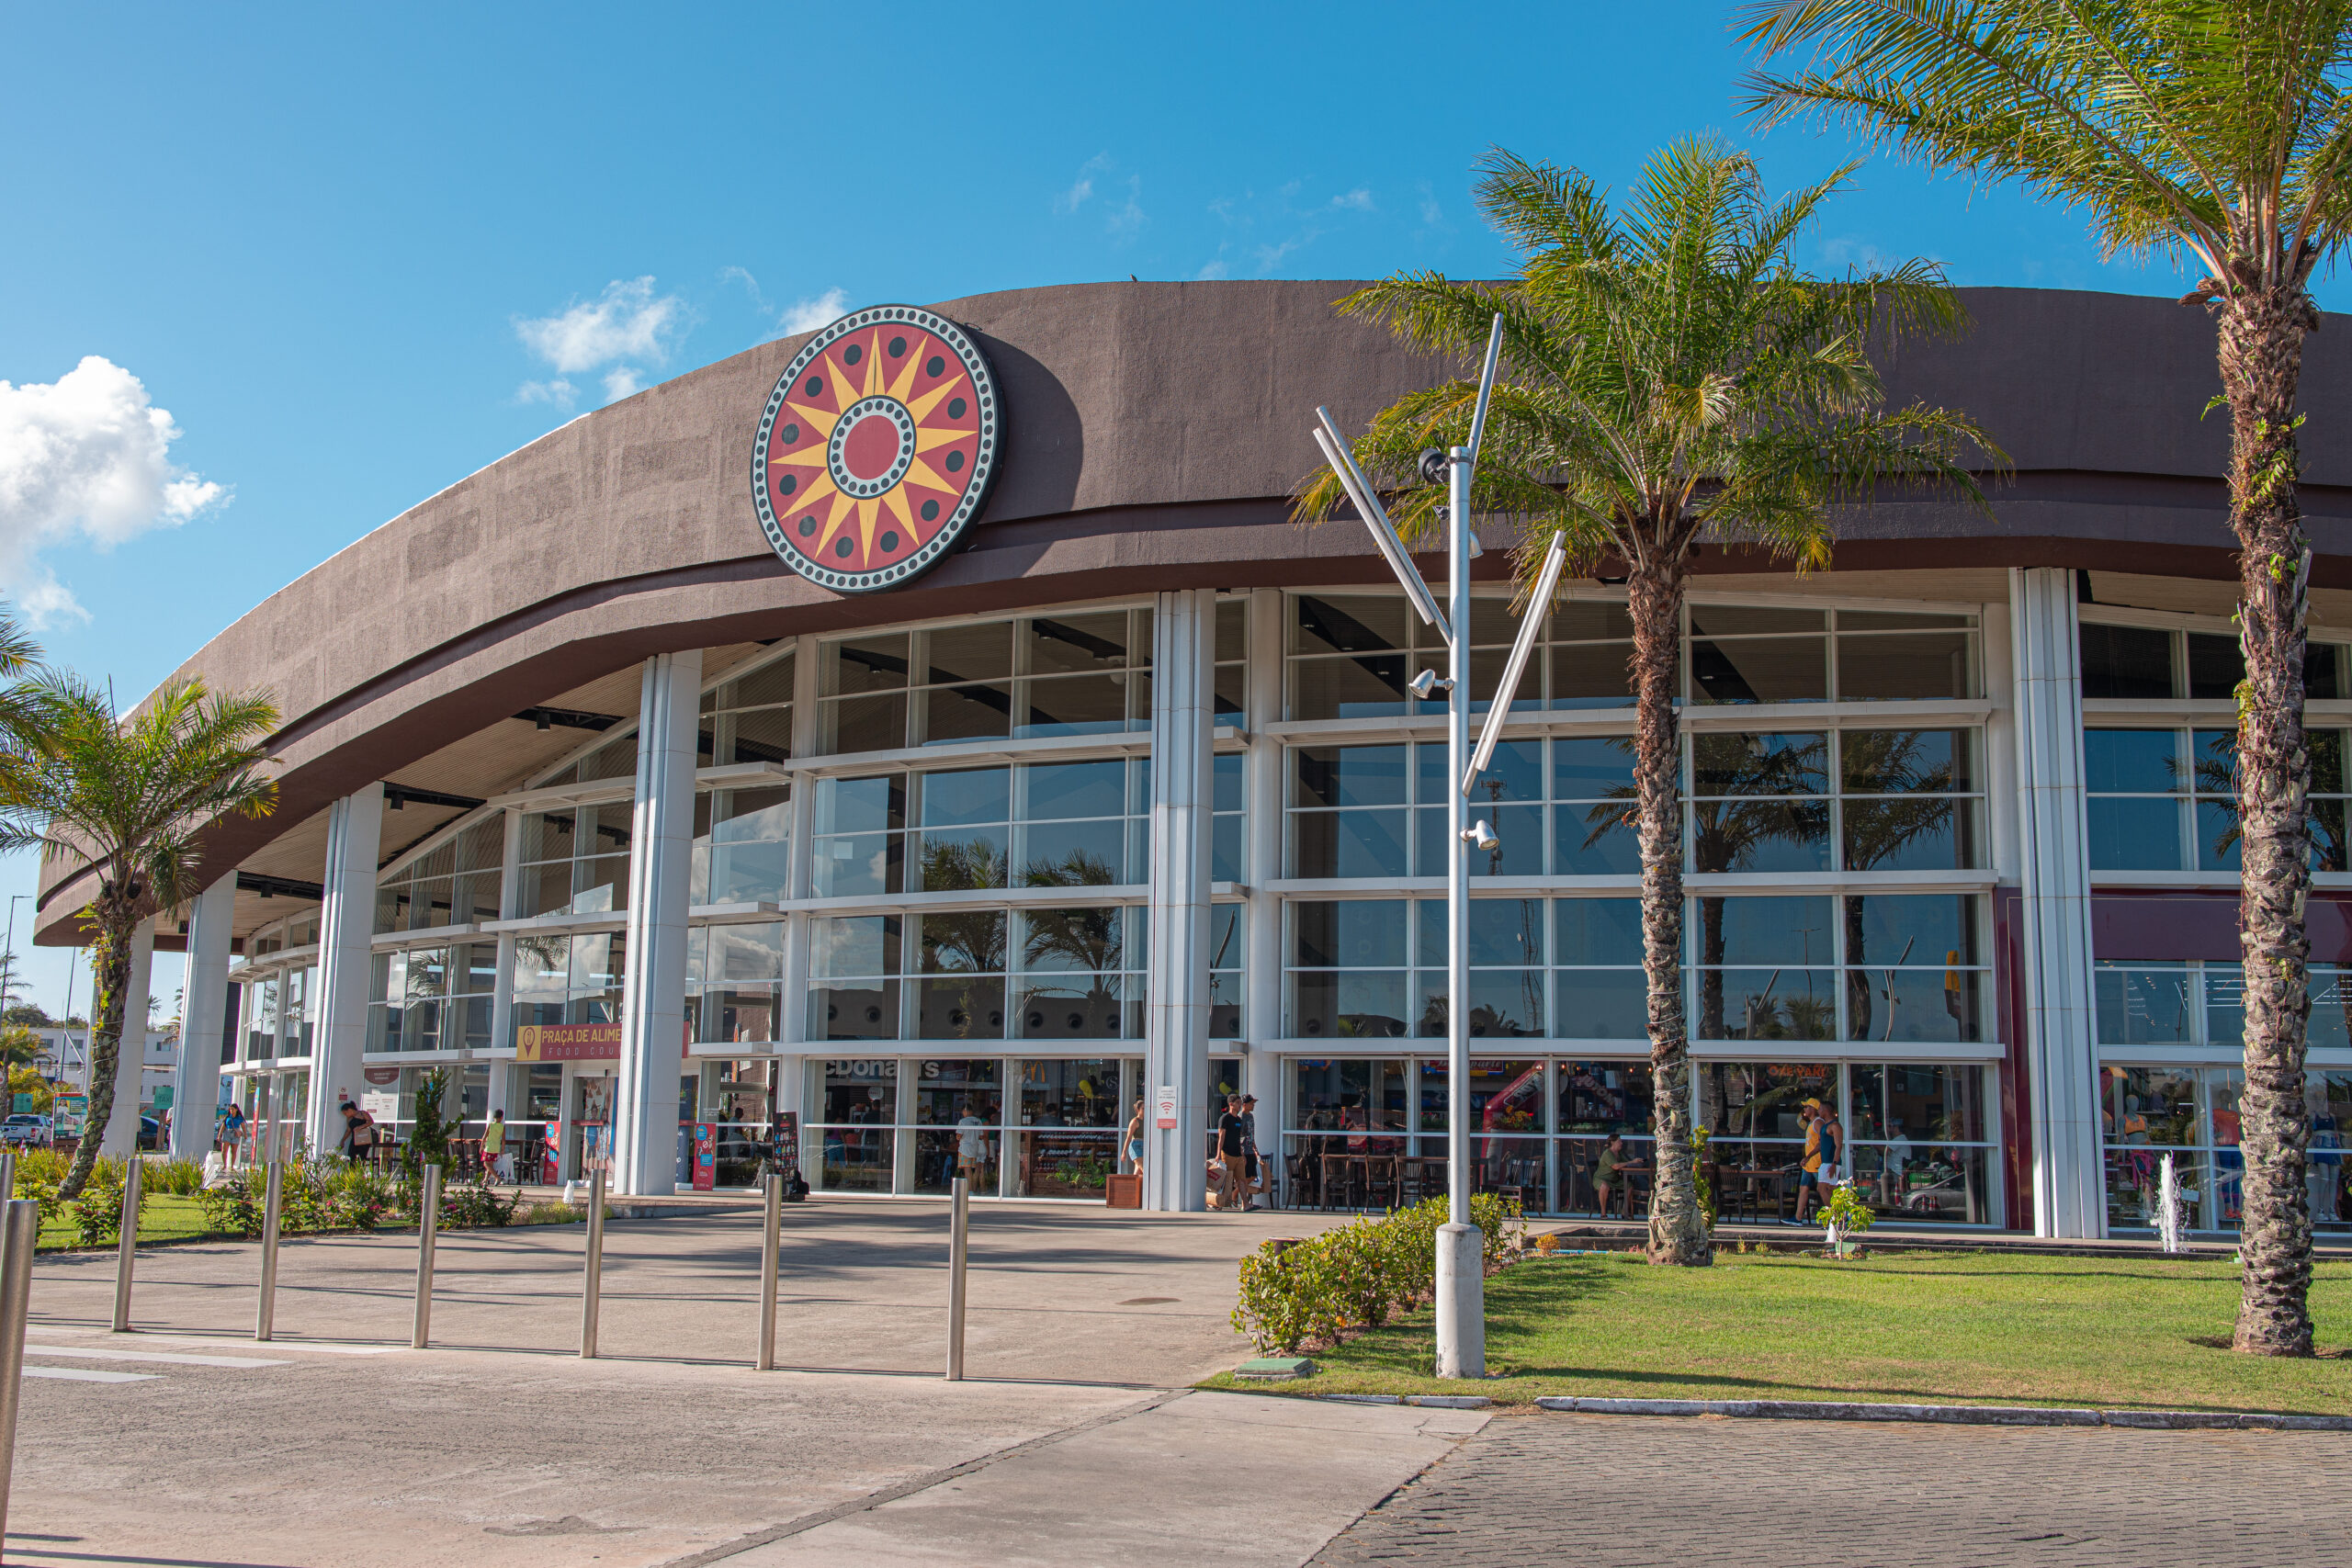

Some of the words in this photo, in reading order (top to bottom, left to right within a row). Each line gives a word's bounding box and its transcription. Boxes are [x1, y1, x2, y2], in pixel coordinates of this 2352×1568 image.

[542, 1030, 574, 1046] PRAÇA
[576, 1029, 589, 1043] DE
[591, 1028, 622, 1042] ALIME
[549, 1047, 580, 1055] FOOD
[590, 1046, 621, 1055] COU
